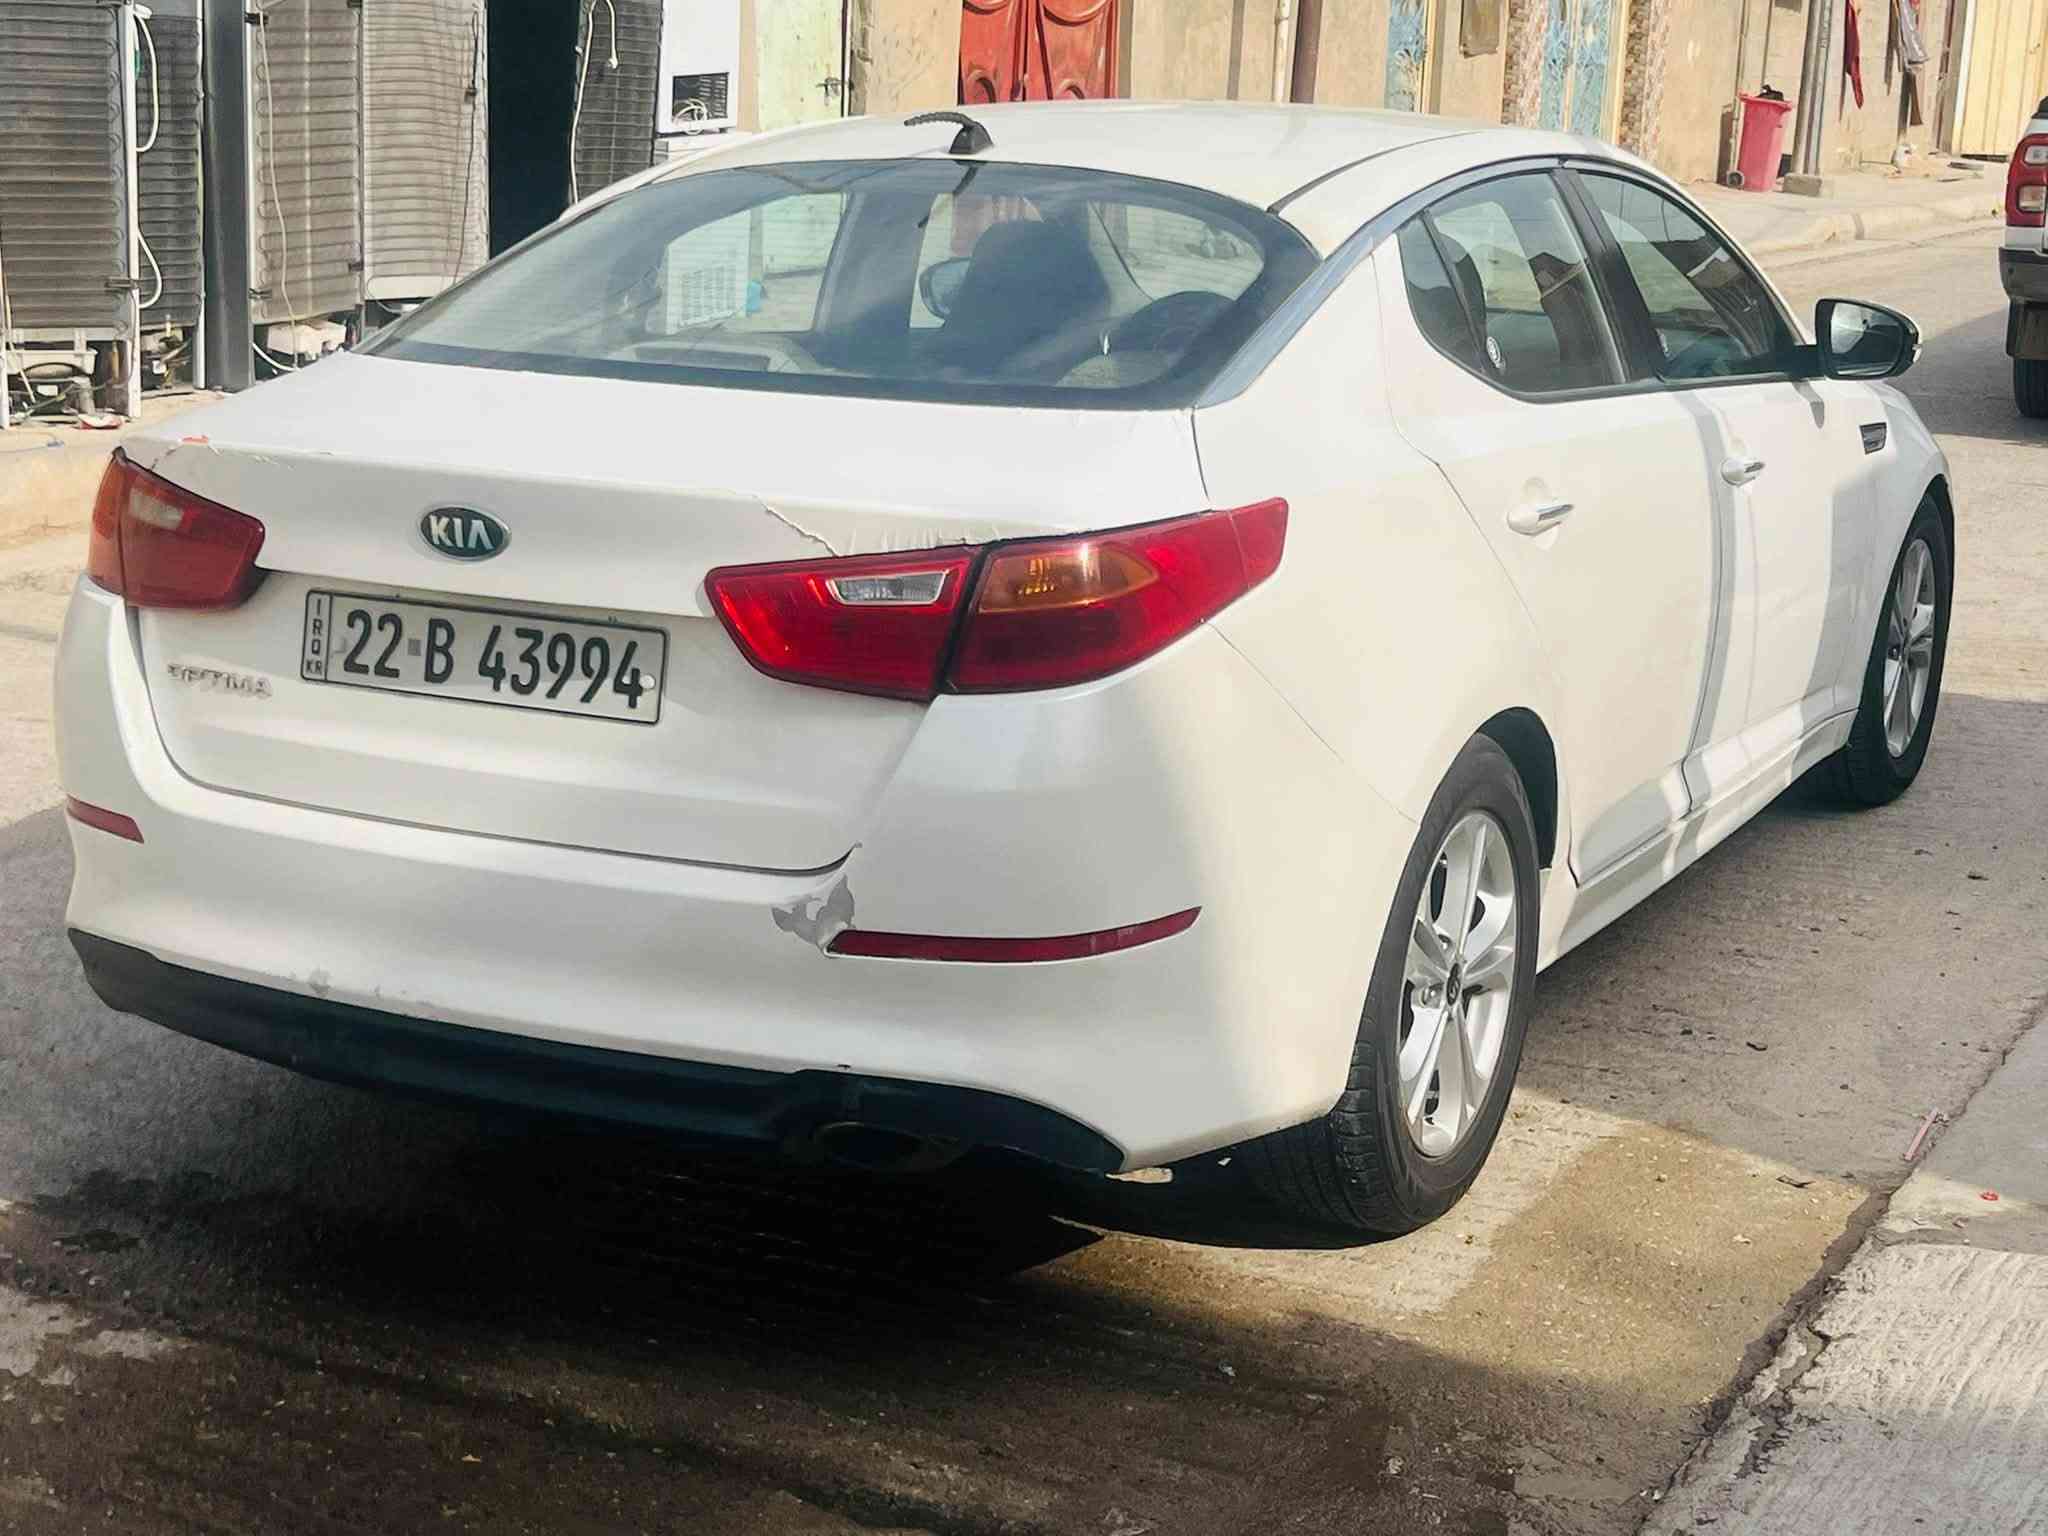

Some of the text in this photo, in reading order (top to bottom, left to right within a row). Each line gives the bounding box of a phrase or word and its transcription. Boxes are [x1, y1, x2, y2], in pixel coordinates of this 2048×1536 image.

[428, 514, 495, 551] KIA
[342, 608, 645, 710] 22 B 43994
